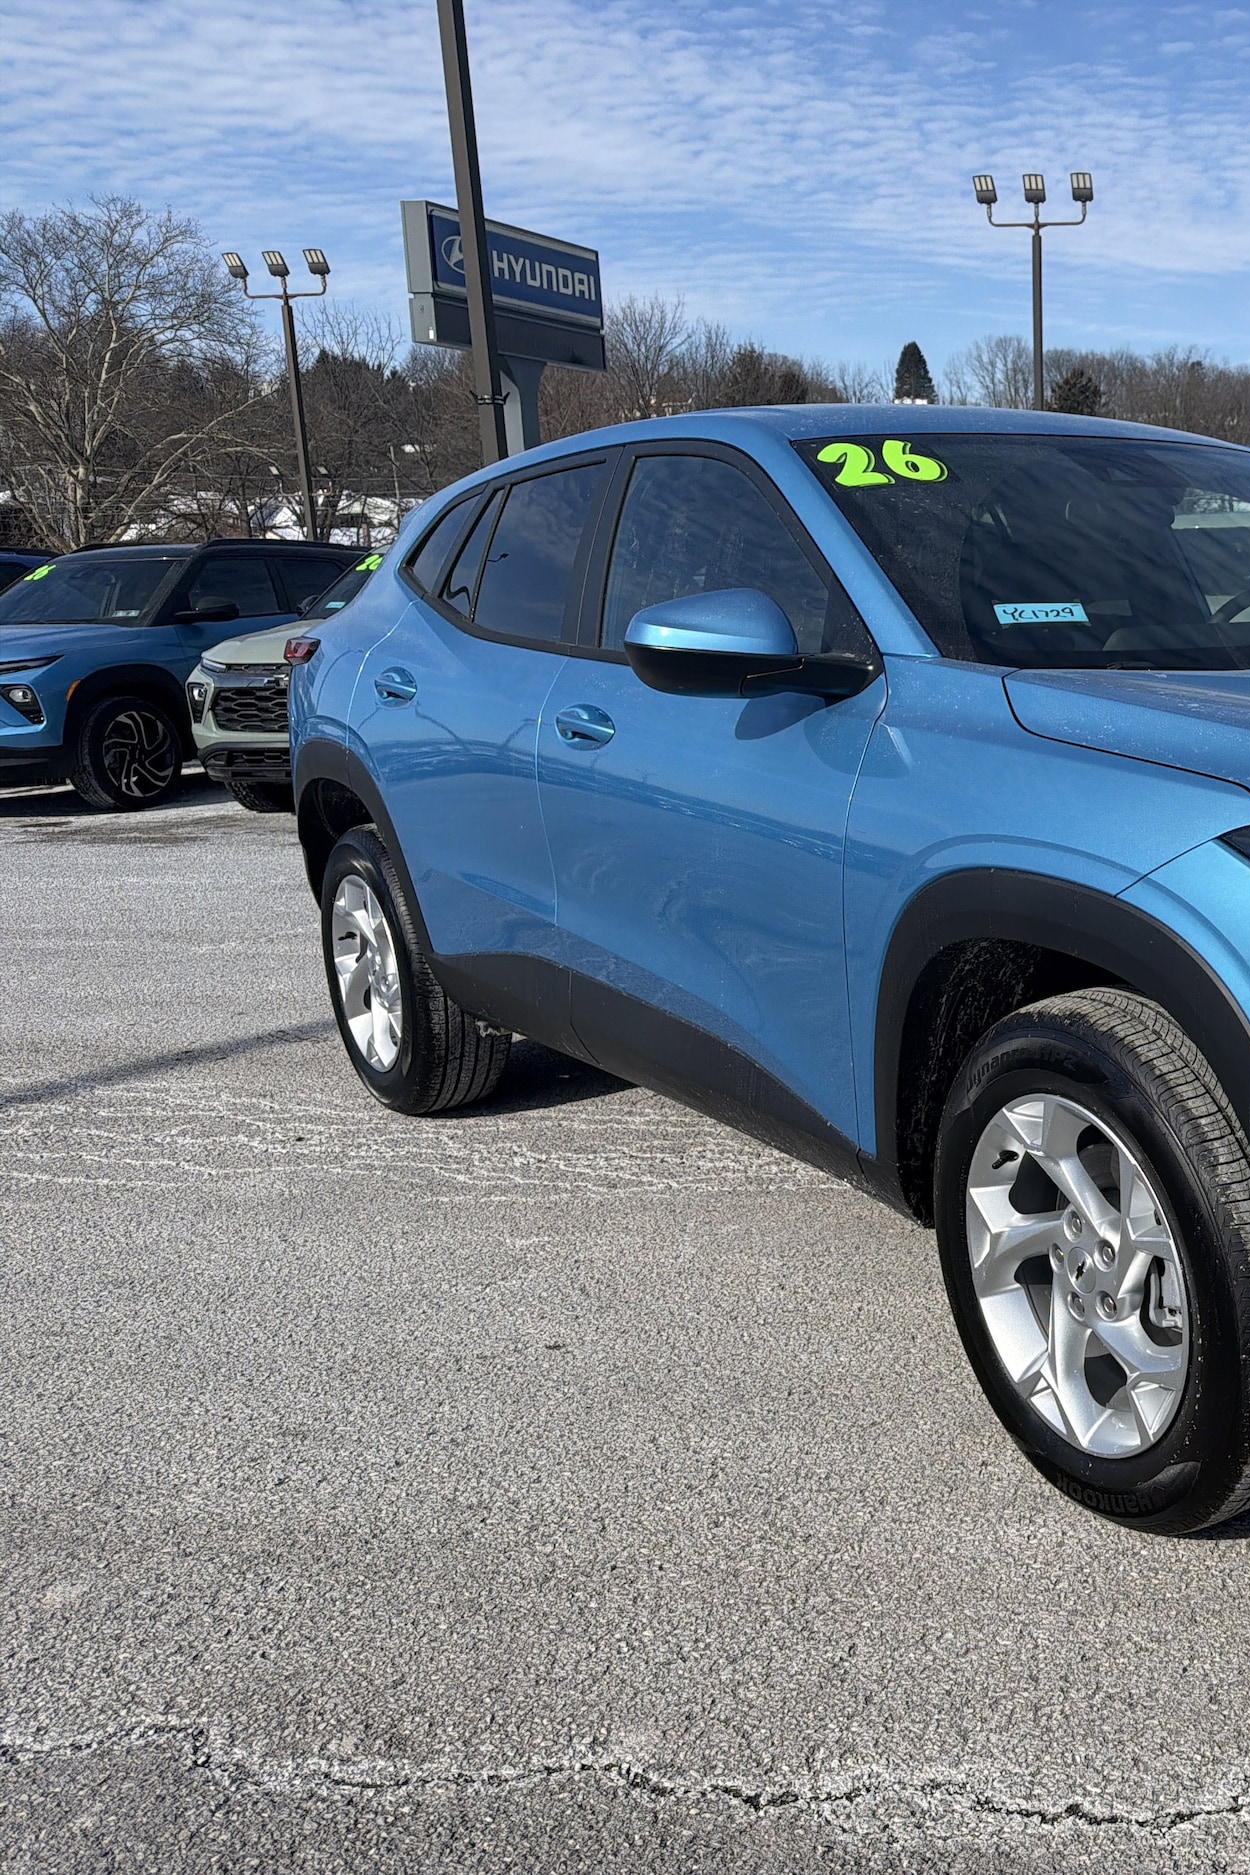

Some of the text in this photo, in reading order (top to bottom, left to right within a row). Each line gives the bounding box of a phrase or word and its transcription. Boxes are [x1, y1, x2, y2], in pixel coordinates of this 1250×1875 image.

[492, 249, 596, 301] HYUNDAI
[817, 439, 949, 487] 26
[1002, 605, 1075, 621] YC1729
